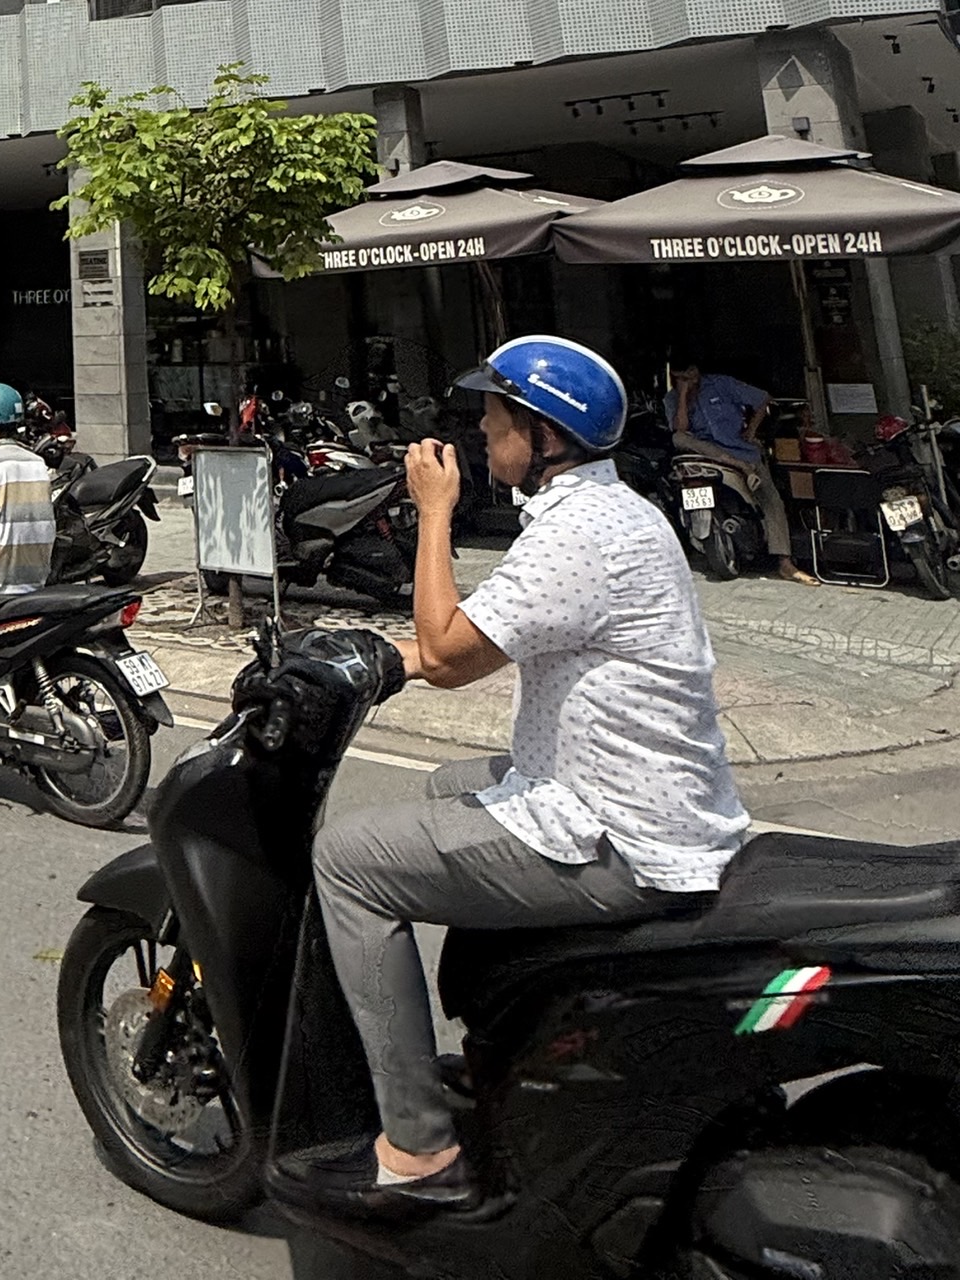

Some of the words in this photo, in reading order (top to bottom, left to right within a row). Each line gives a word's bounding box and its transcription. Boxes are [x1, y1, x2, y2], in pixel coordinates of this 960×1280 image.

[457, 236, 486, 258] 24H
[650, 236, 704, 259] THREE
[844, 231, 882, 253] 24H
[12, 289, 51, 304] THREE
